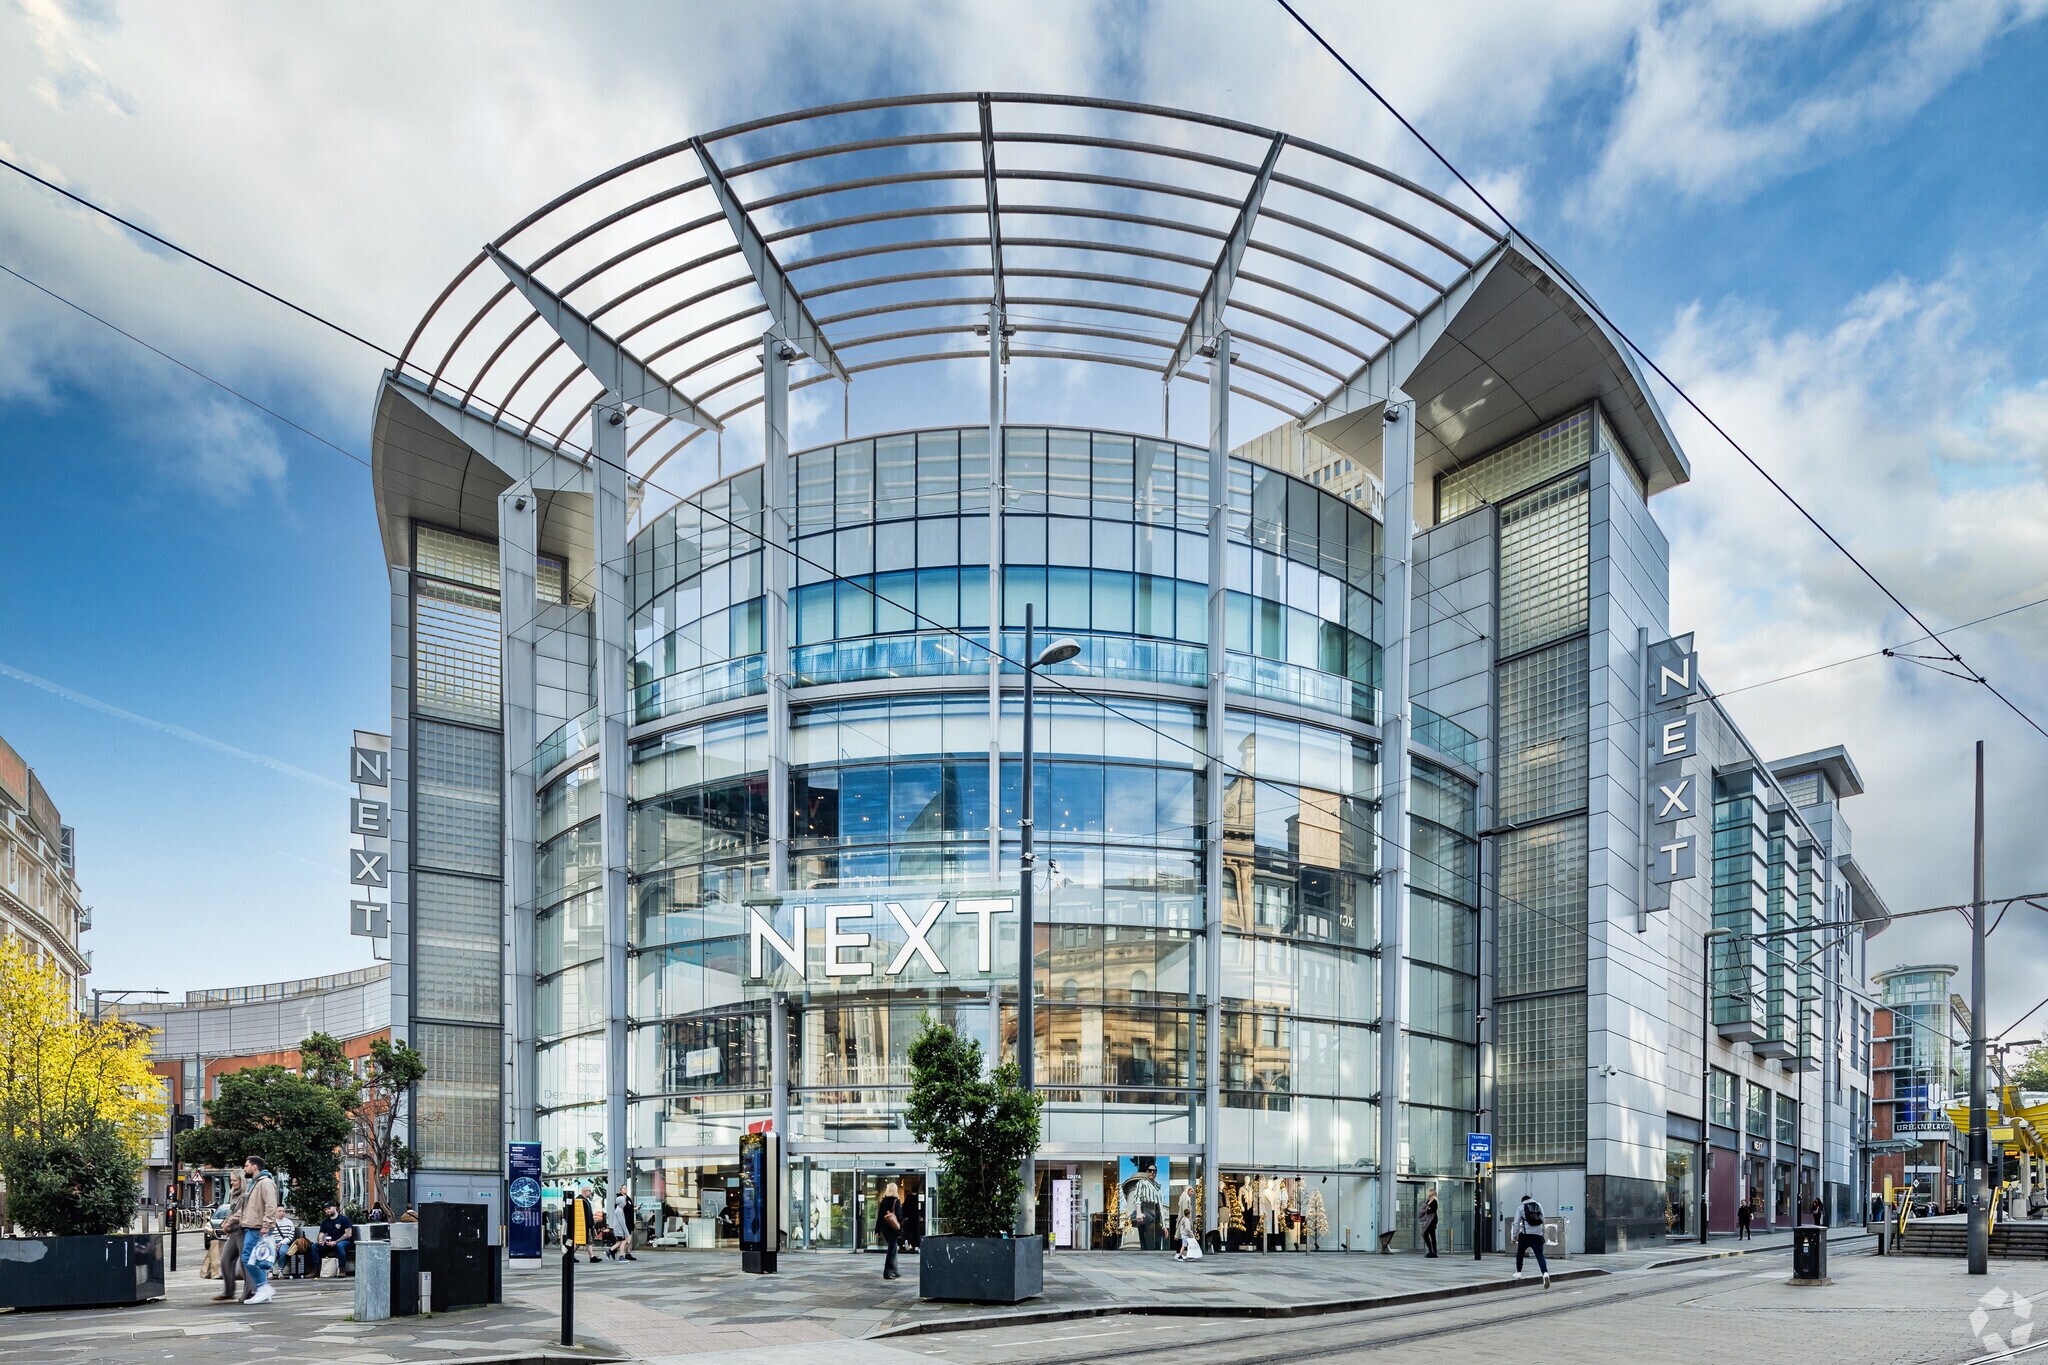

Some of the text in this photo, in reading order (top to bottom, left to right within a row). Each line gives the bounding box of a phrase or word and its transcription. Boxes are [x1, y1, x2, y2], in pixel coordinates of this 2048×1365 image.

[355, 750, 382, 932] NEXT
[1658, 657, 1690, 876] NEXT
[749, 898, 1014, 980] NEXT
